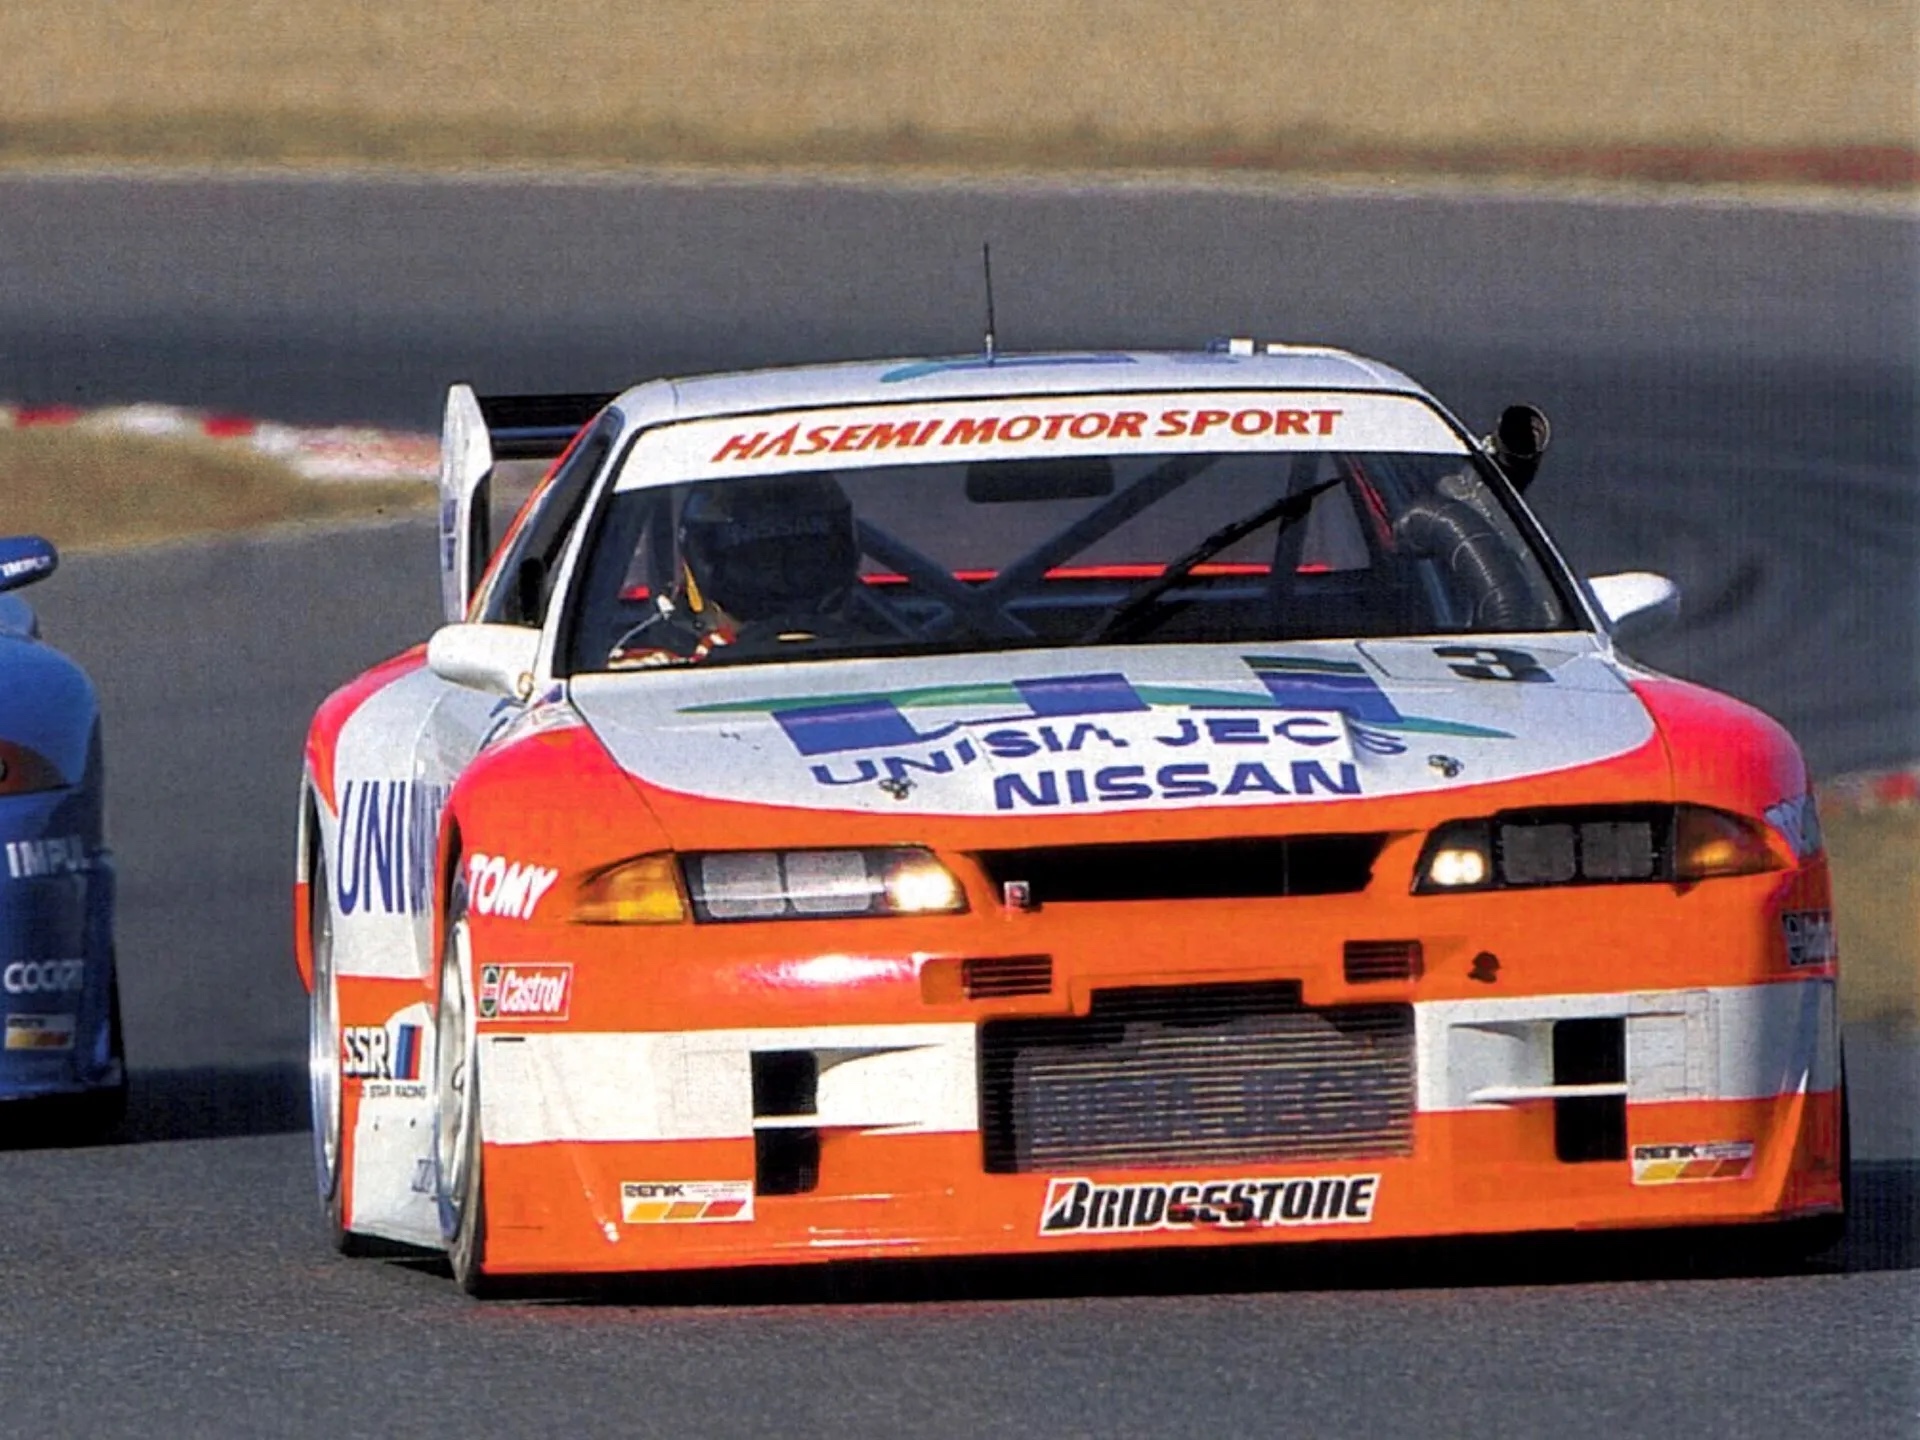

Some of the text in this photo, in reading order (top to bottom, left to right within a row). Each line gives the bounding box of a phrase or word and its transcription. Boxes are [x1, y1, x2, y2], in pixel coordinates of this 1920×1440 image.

[710, 408, 1344, 464] HASEMI MOTOR SPORT
[1432, 645, 1557, 683] 3
[992, 761, 1363, 810] NISSAN
[468, 854, 558, 920] TOMY
[500, 968, 568, 1013] Castrol
[1043, 1177, 1375, 1231] BRIDGESTONE
